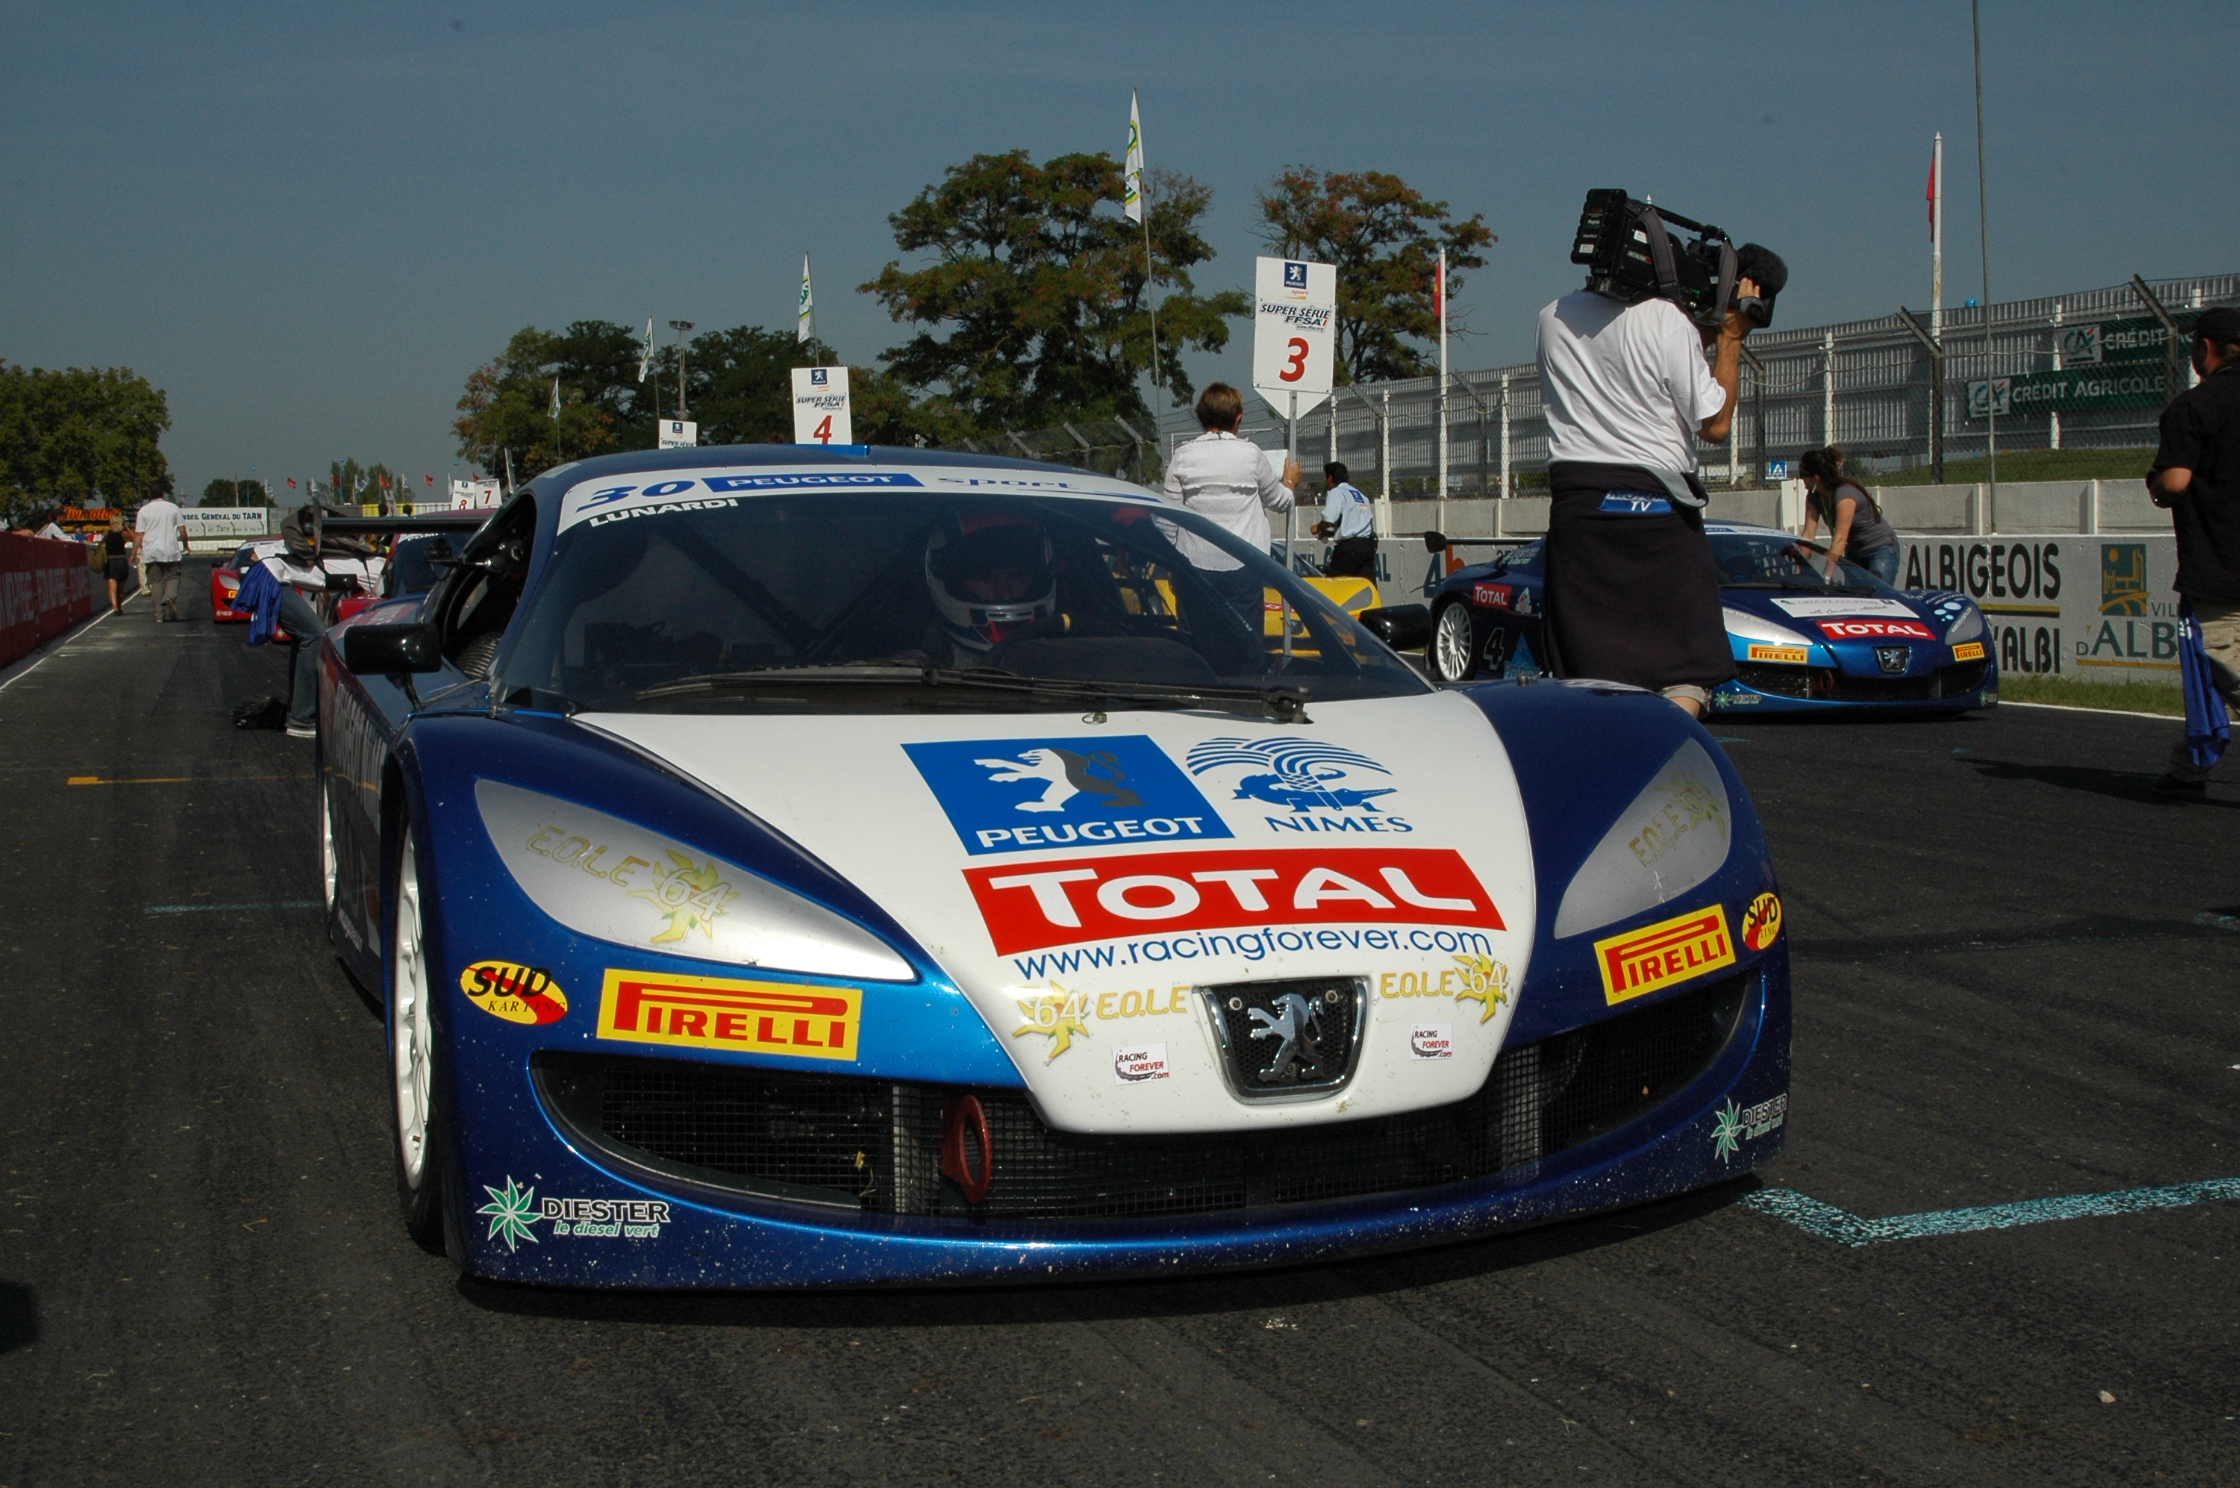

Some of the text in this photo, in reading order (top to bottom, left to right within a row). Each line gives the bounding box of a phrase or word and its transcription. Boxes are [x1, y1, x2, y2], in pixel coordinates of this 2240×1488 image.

[1260, 304, 1331, 319] SUPER SÉRIE
[2105, 328, 2166, 350] CRÉDIT
[1278, 337, 1310, 382] 3
[796, 396, 822, 404] SUPER
[2013, 375, 2166, 402] CRÉDIT AGRICOLE
[813, 414, 832, 444] 4
[459, 499, 467, 510] 8
[484, 490, 492, 504] 7
[576, 475, 1079, 513] 30 PEUGEOT sport
[1630, 500, 1652, 512] TV
[242, 512, 262, 520] TARN
[589, 498, 738, 527] LUNARDI
[1905, 543, 2061, 600] ALBIGEOIS
[1475, 586, 1508, 606] TOTAL
[1821, 621, 1928, 637] TOTAL
[1483, 627, 1505, 671] 4
[1751, 647, 1804, 661] PIRELLI
[1954, 645, 1983, 659] PIRELLI
[1993, 626, 2061, 674] 'ALBI
[976, 817, 1203, 848] PEUGEOT
[1264, 816, 1413, 833] NIMES
[658, 867, 732, 922] 64
[988, 867, 1477, 928] TOTAL
[1747, 896, 1778, 928] SUD
[1013, 926, 1493, 980] www.racingforever.com
[1604, 915, 1728, 992] PIRELLI
[467, 966, 552, 997] SUD
[1380, 961, 1507, 998] E.O.L.E 64
[487, 1000, 567, 1014] KARTING
[613, 980, 848, 1049] PIRELLI
[1033, 985, 1191, 1028] 64 E.O.L.E
[1414, 1030, 1438, 1039] RACING
[1422, 1040, 1450, 1049] FOREVER
[1118, 1051, 1148, 1063] RACING
[1438, 1050, 1452, 1058] .com
[1129, 1061, 1164, 1073] FOREVER
[1151, 1071, 1170, 1080] .com
[1742, 1093, 1787, 1128] DIESTER
[542, 1197, 671, 1223] DIESTER
[554, 1220, 660, 1238] le diesel vert
